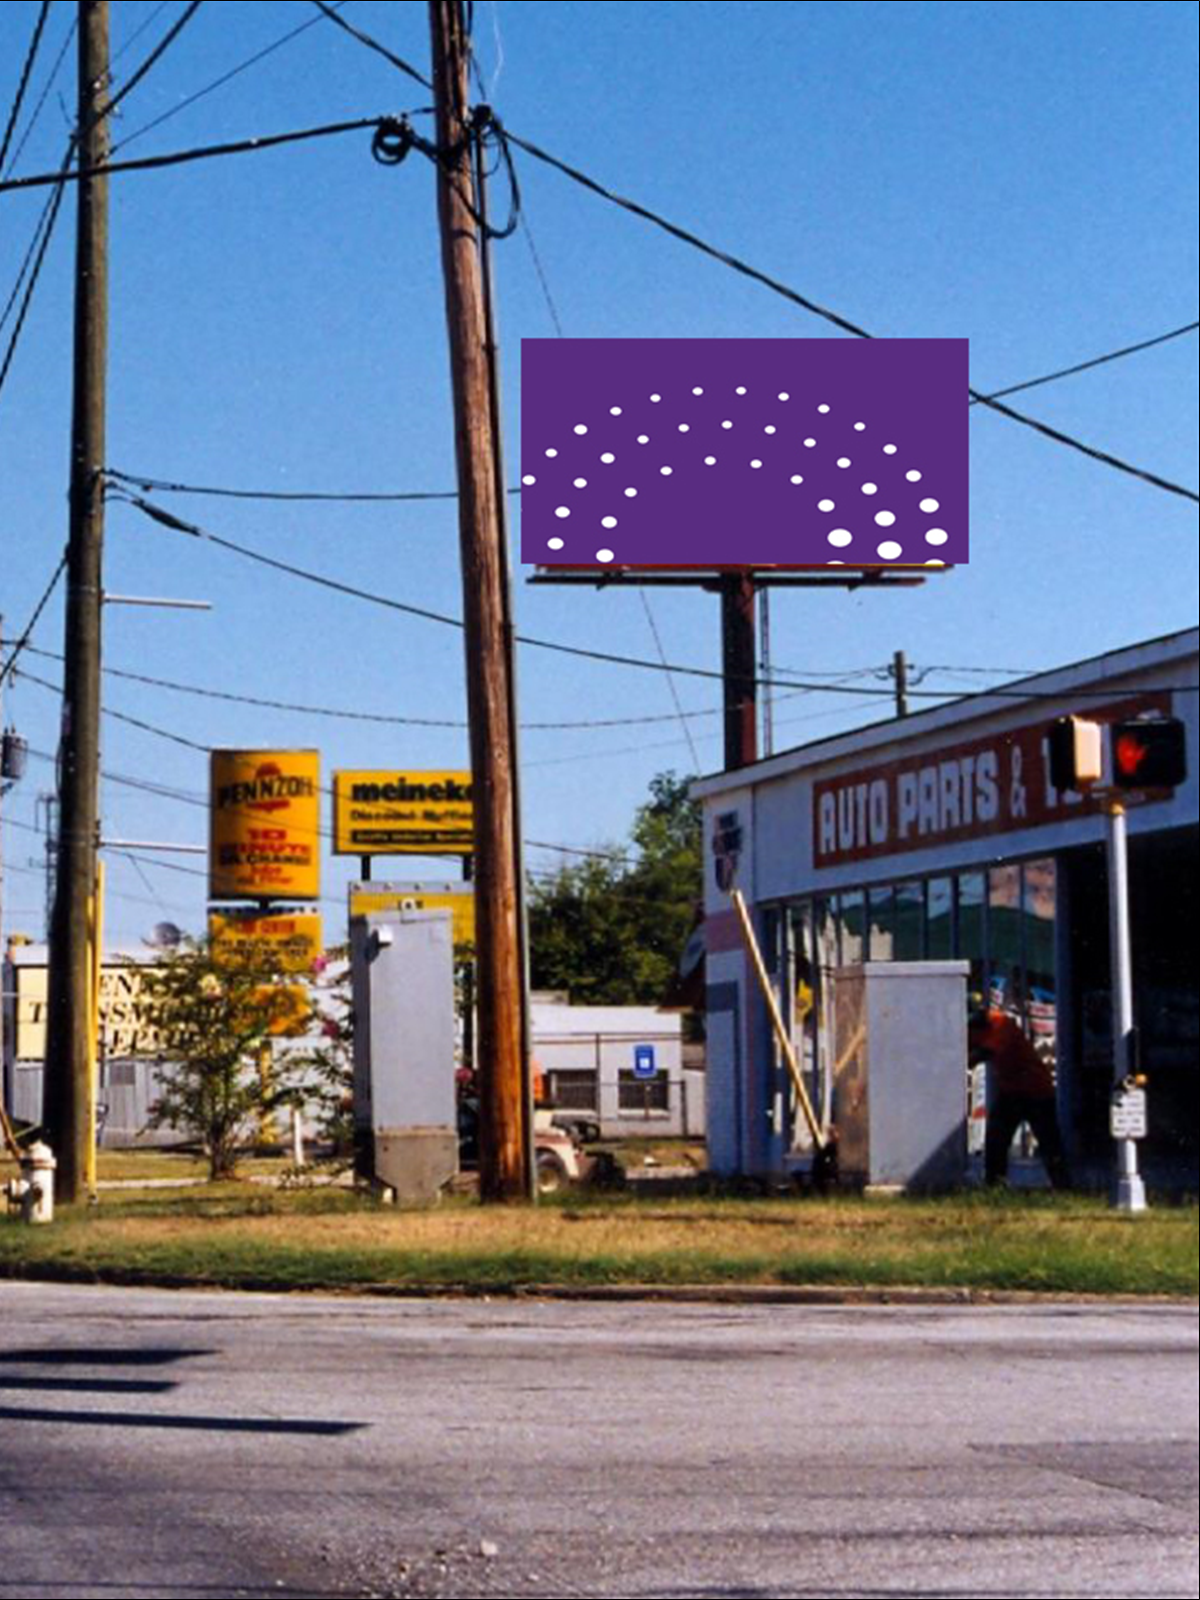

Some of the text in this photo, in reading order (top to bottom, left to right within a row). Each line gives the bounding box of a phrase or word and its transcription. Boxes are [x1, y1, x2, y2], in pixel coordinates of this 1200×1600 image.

[819, 779, 888, 854] AUTO
[896, 749, 999, 839] PARTS
[1010, 745, 1027, 818] &
